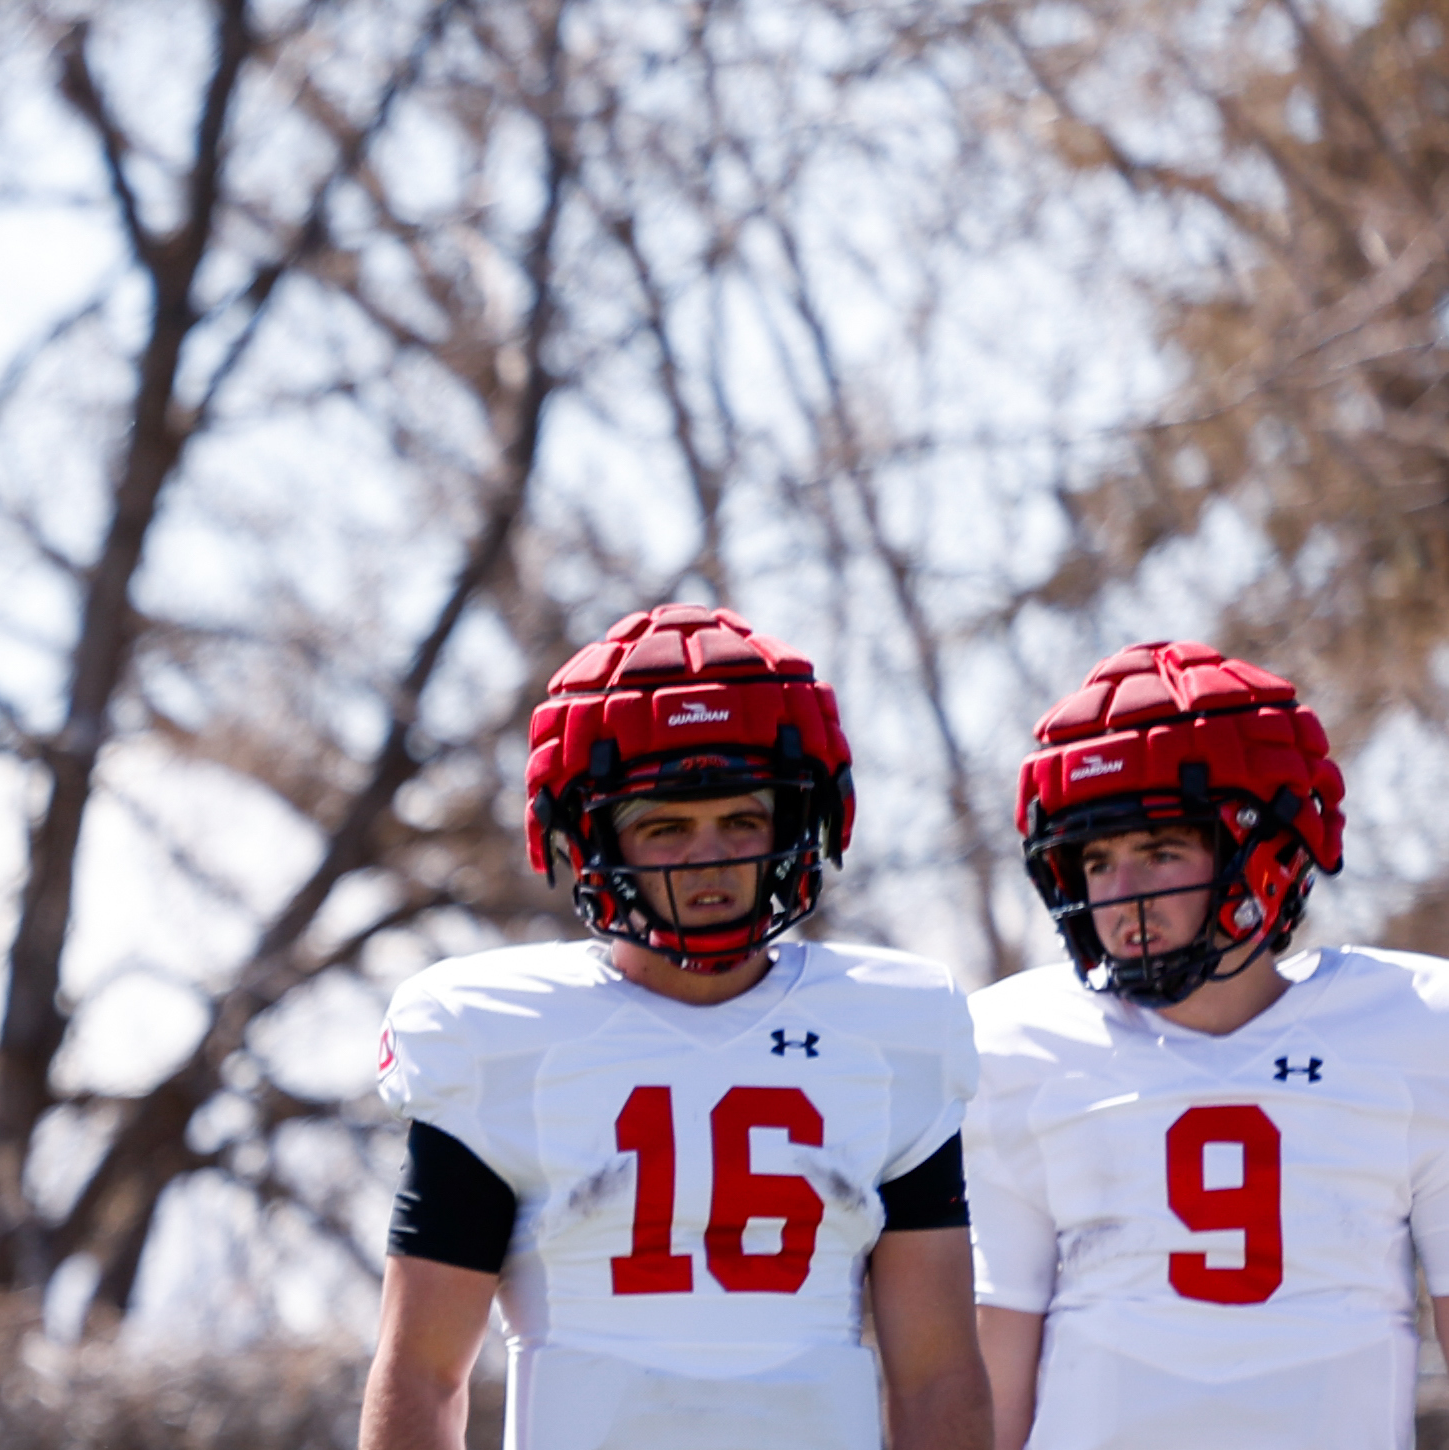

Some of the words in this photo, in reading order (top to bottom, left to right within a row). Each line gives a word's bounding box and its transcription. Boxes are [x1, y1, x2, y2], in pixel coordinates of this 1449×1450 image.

[668, 709, 729, 727] GUARDIAN
[610, 1085, 825, 1296] 16
[1165, 1104, 1284, 1307] 9
